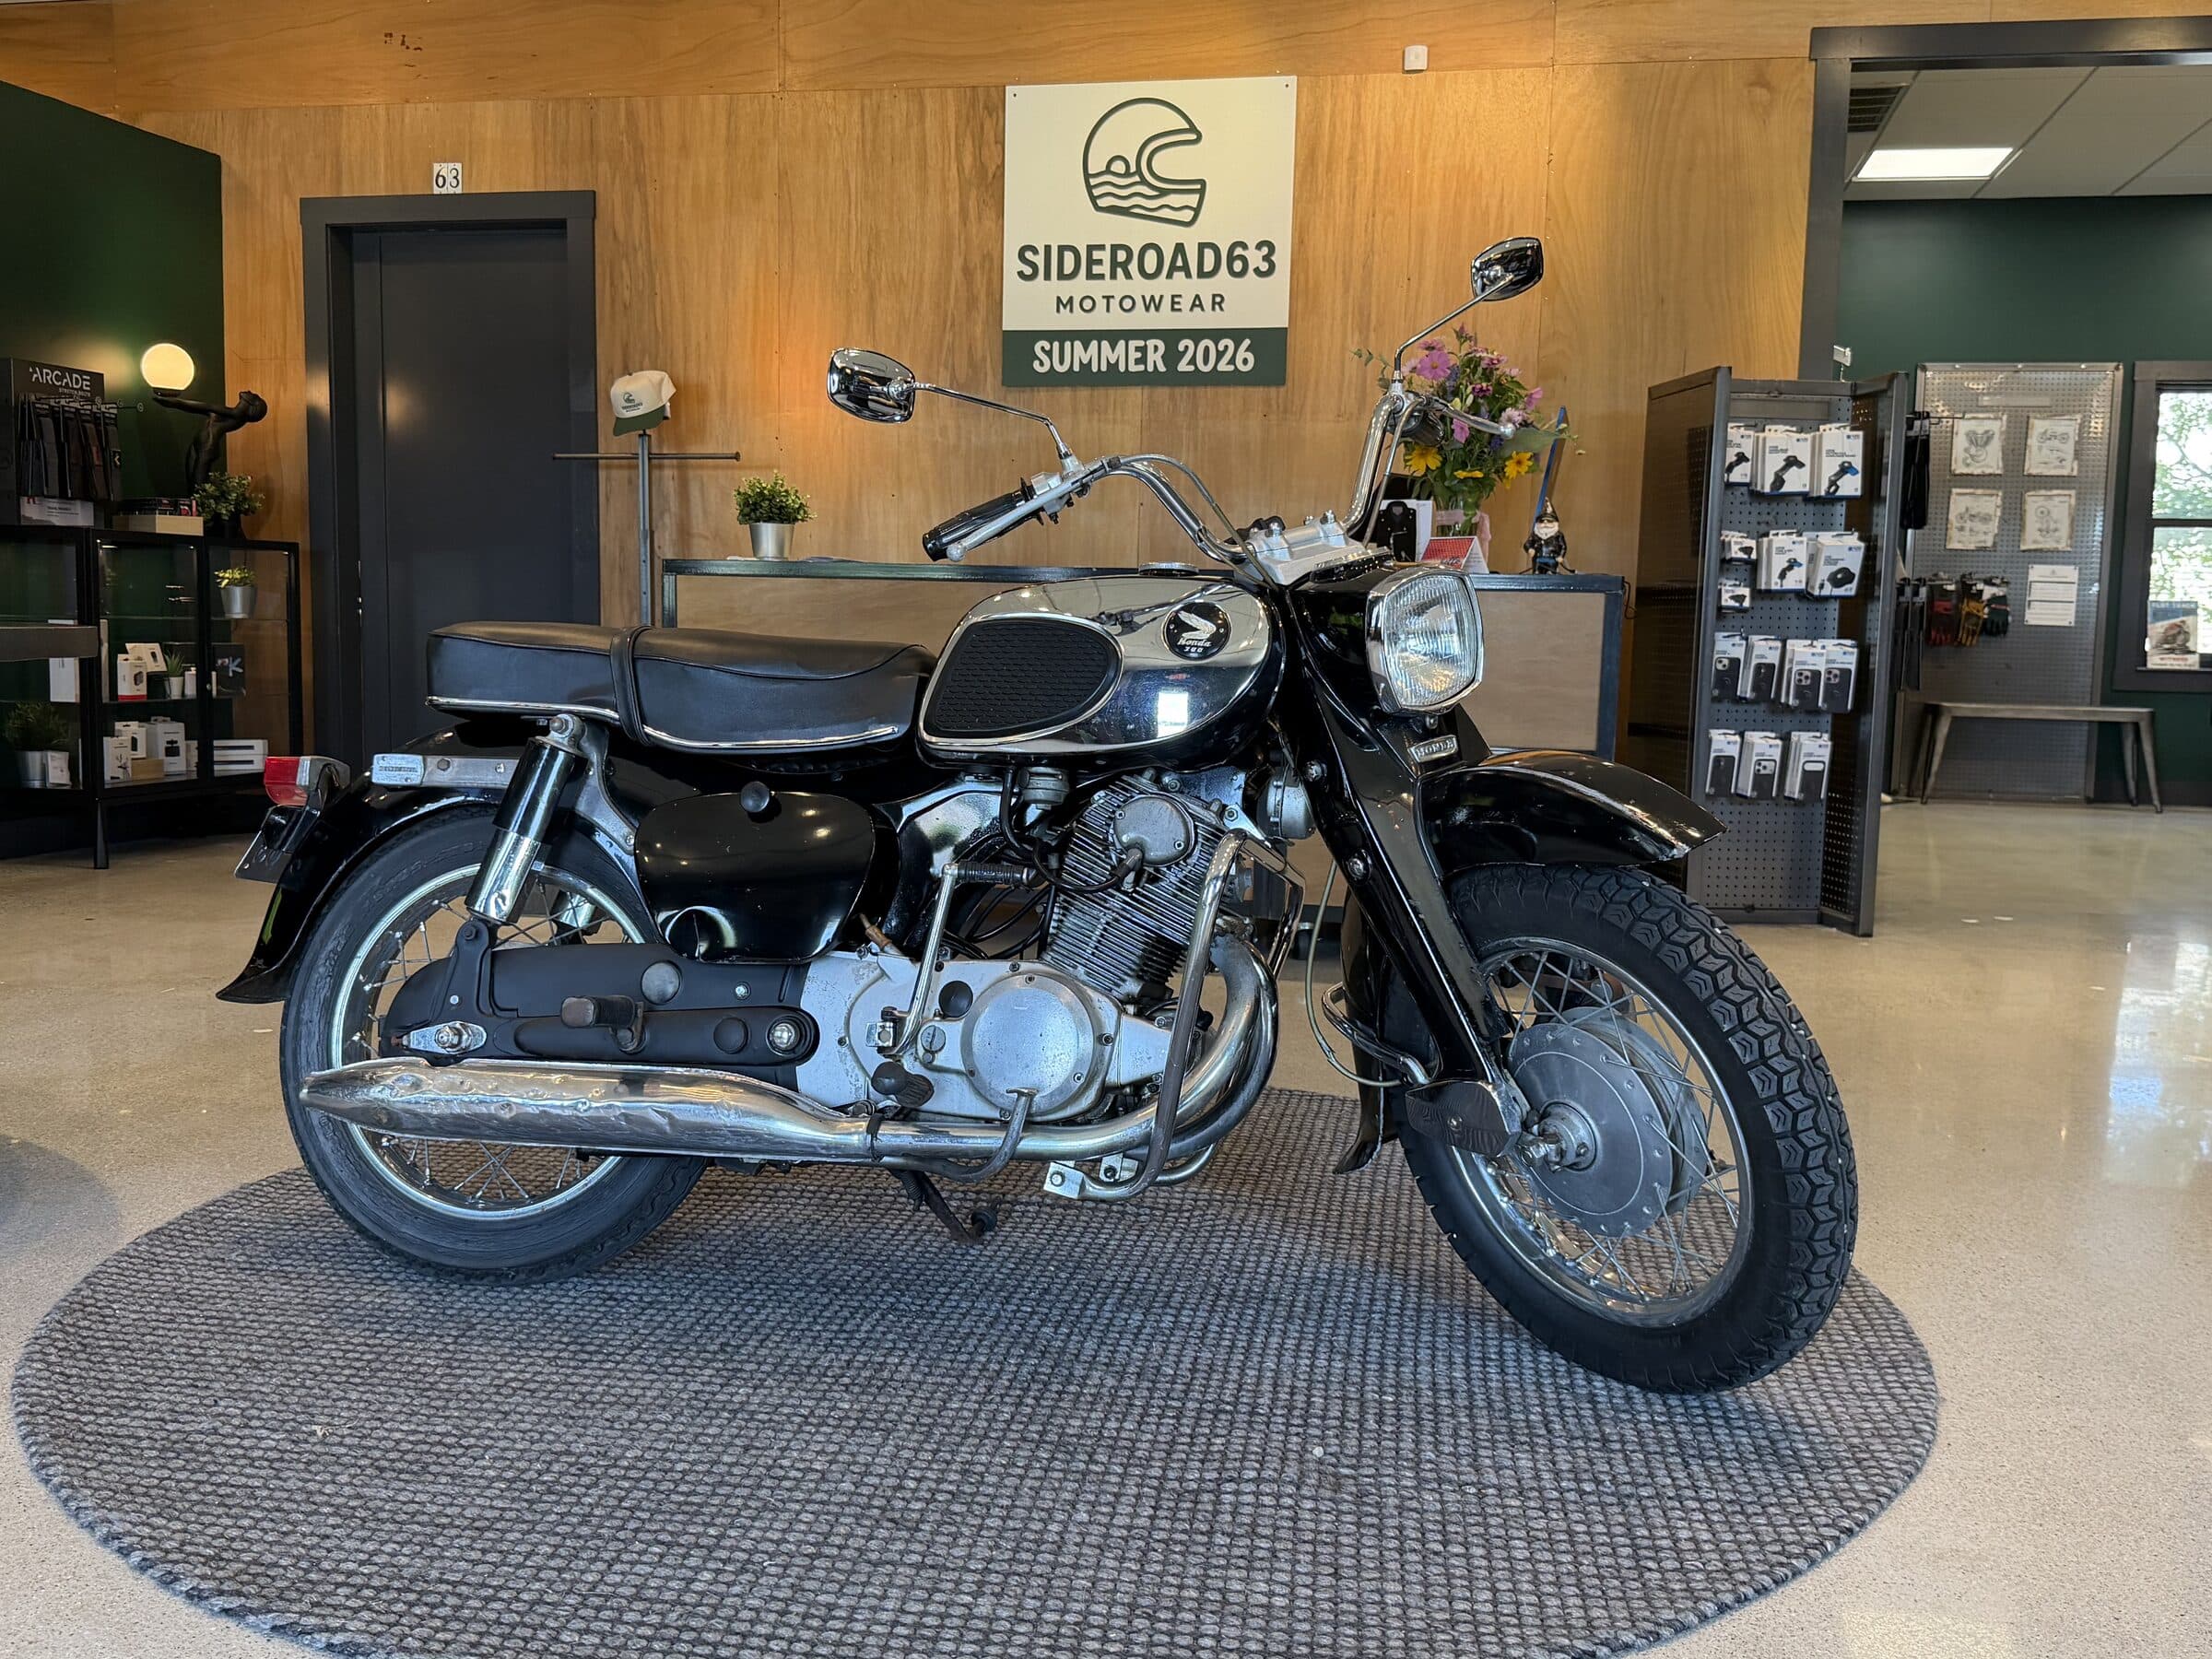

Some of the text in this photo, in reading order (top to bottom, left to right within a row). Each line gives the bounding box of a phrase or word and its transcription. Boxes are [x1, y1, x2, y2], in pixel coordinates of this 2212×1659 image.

[435, 167, 459, 189] 63
[1017, 240, 1277, 281] SIDEROAD63
[1055, 293, 1226, 313] MOTOWEAR
[1032, 337, 1255, 373] SUMMER 2026
[29, 366, 90, 391] ARCADE
[1177, 638, 1212, 647] Honda
[1417, 738, 1453, 757] HONDA
